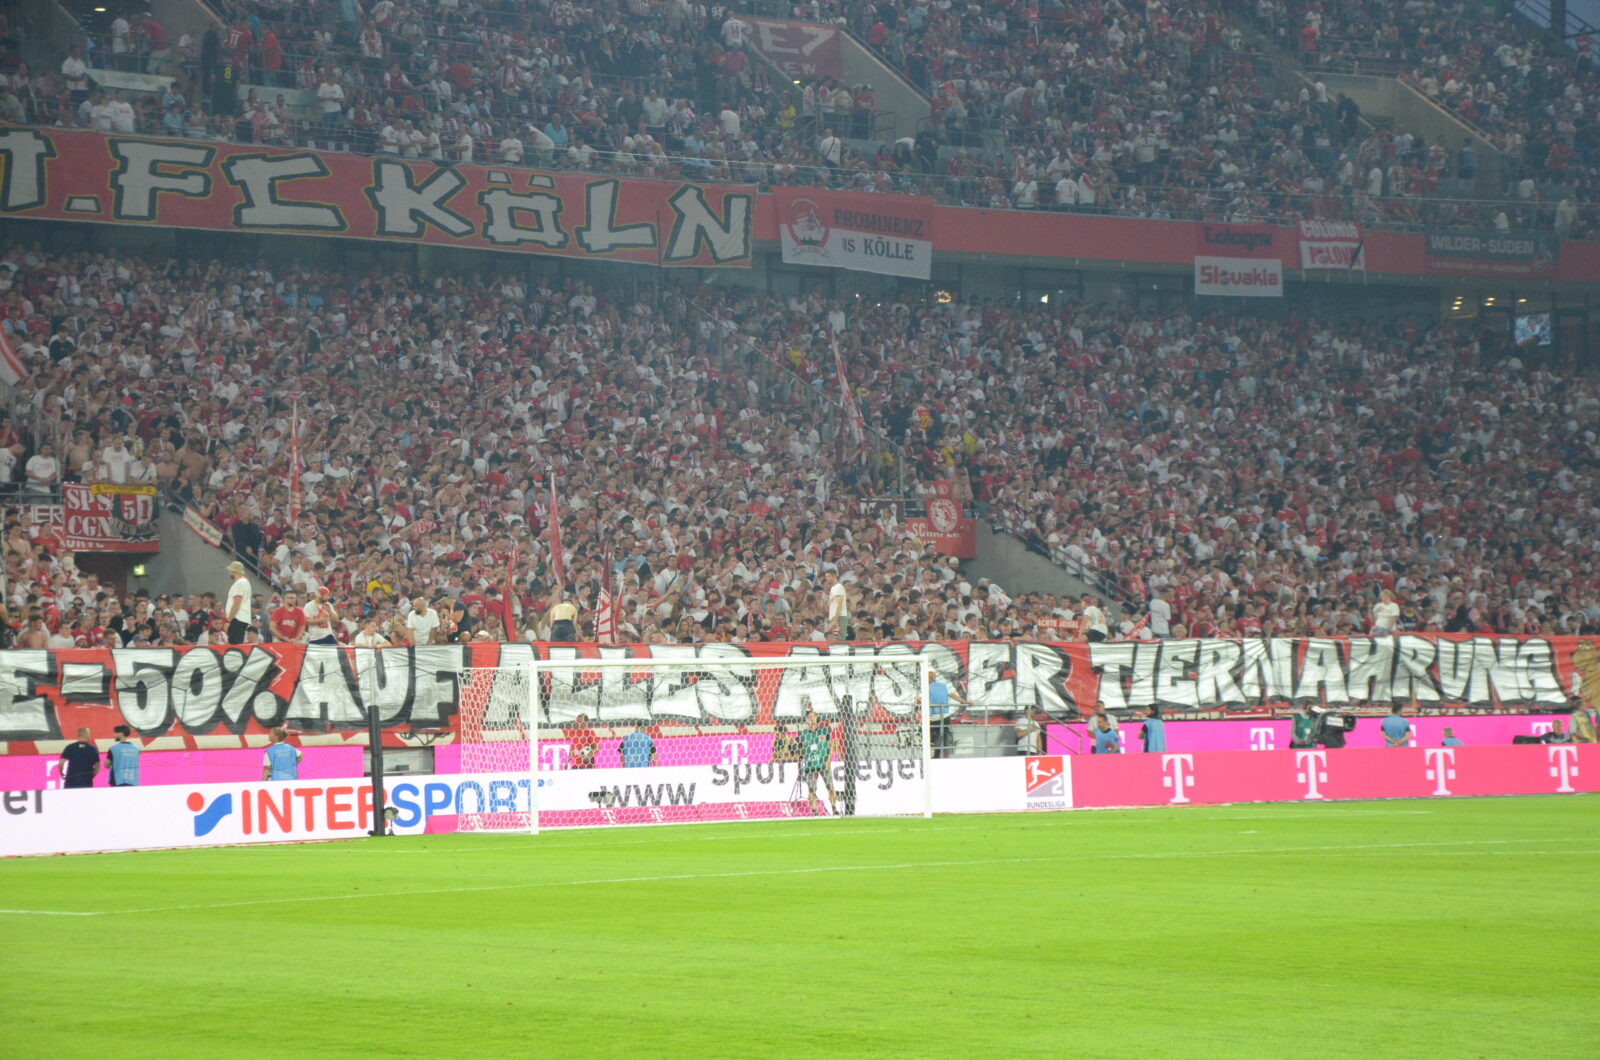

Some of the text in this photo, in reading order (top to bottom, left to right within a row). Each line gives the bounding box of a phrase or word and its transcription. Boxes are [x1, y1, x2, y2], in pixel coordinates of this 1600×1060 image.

[363, 158, 755, 264] KÖLN
[833, 207, 926, 237] PROMINENZ
[863, 236, 915, 261] KÖLLE
[286, 643, 467, 731] AUF
[483, 642, 758, 728] ALLES
[1088, 634, 1570, 712] TIERNAHRUNG
[242, 778, 545, 836] INTERSPORT
[1027, 801, 1066, 809] BUNDESLIGA
